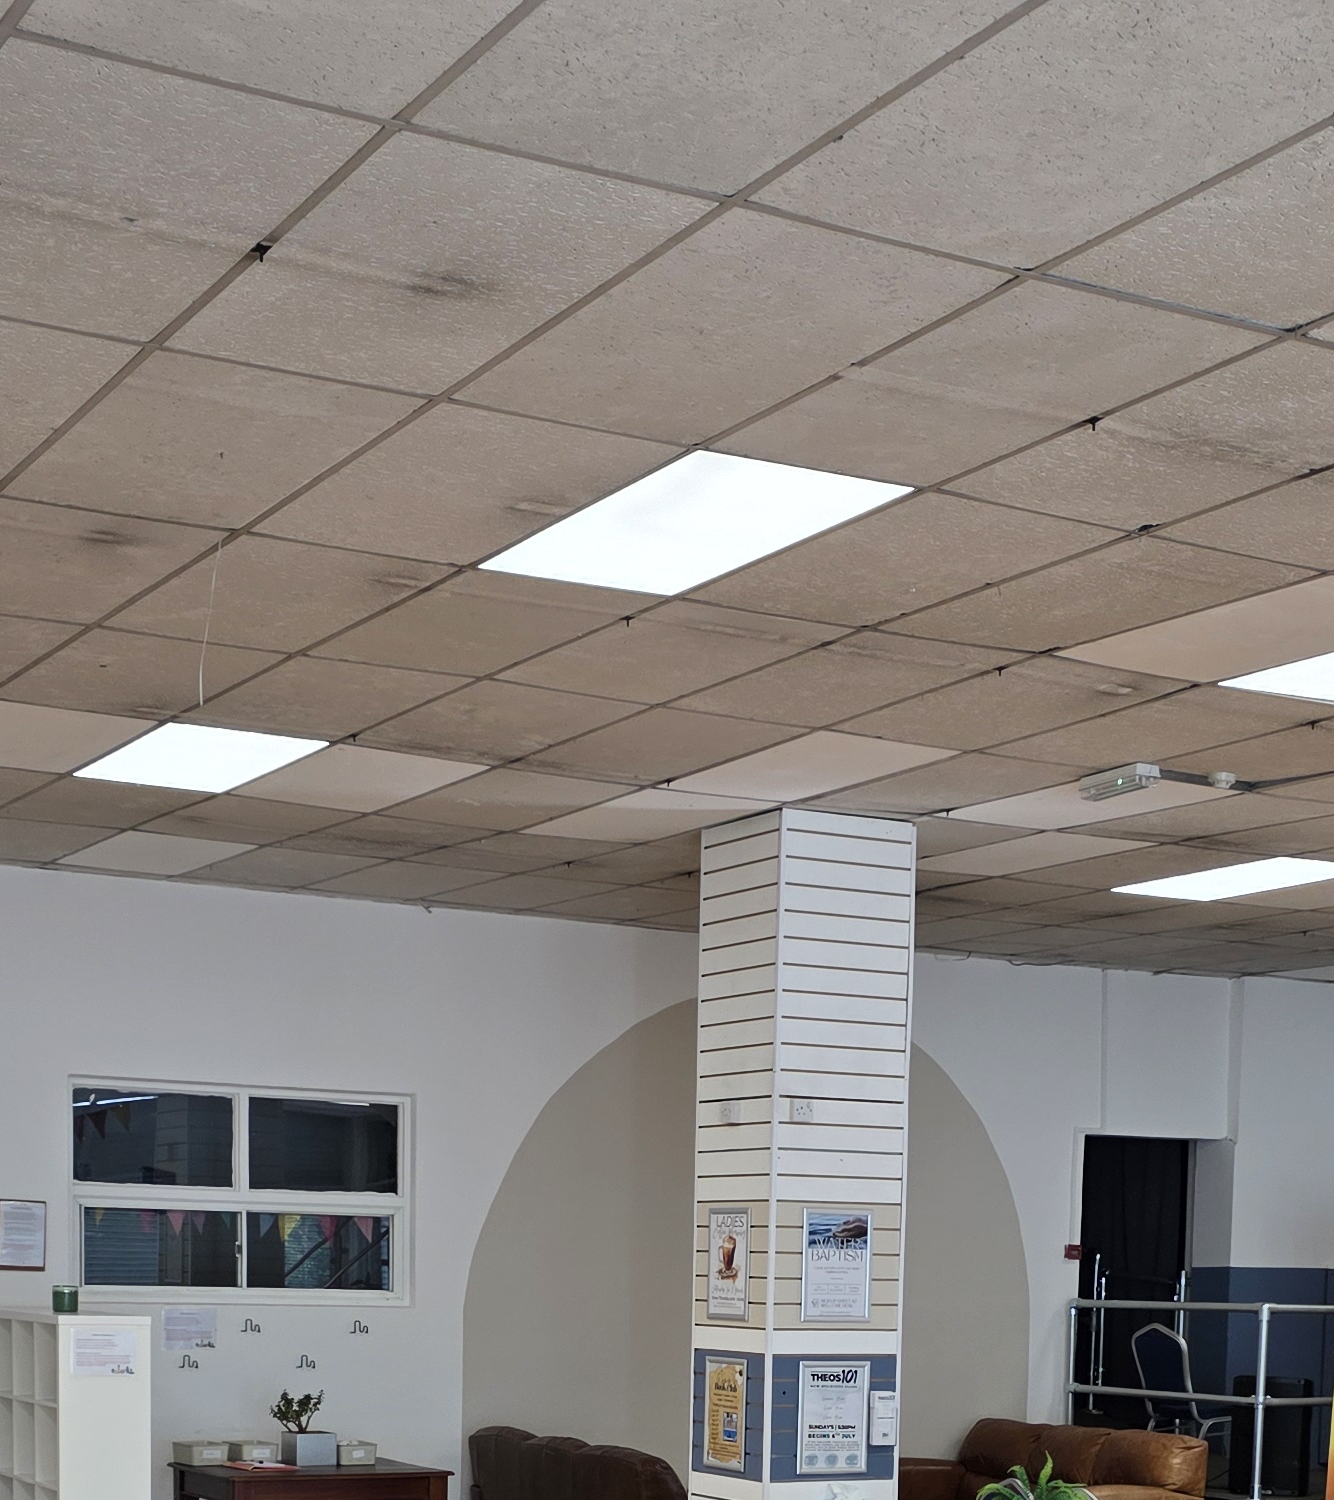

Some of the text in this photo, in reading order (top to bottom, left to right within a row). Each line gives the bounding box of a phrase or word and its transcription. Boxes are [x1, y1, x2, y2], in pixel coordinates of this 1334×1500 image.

[716, 1216, 744, 1227] LADIES
[815, 1238, 863, 1250] WATER
[811, 1250, 863, 1262] BAPTISM
